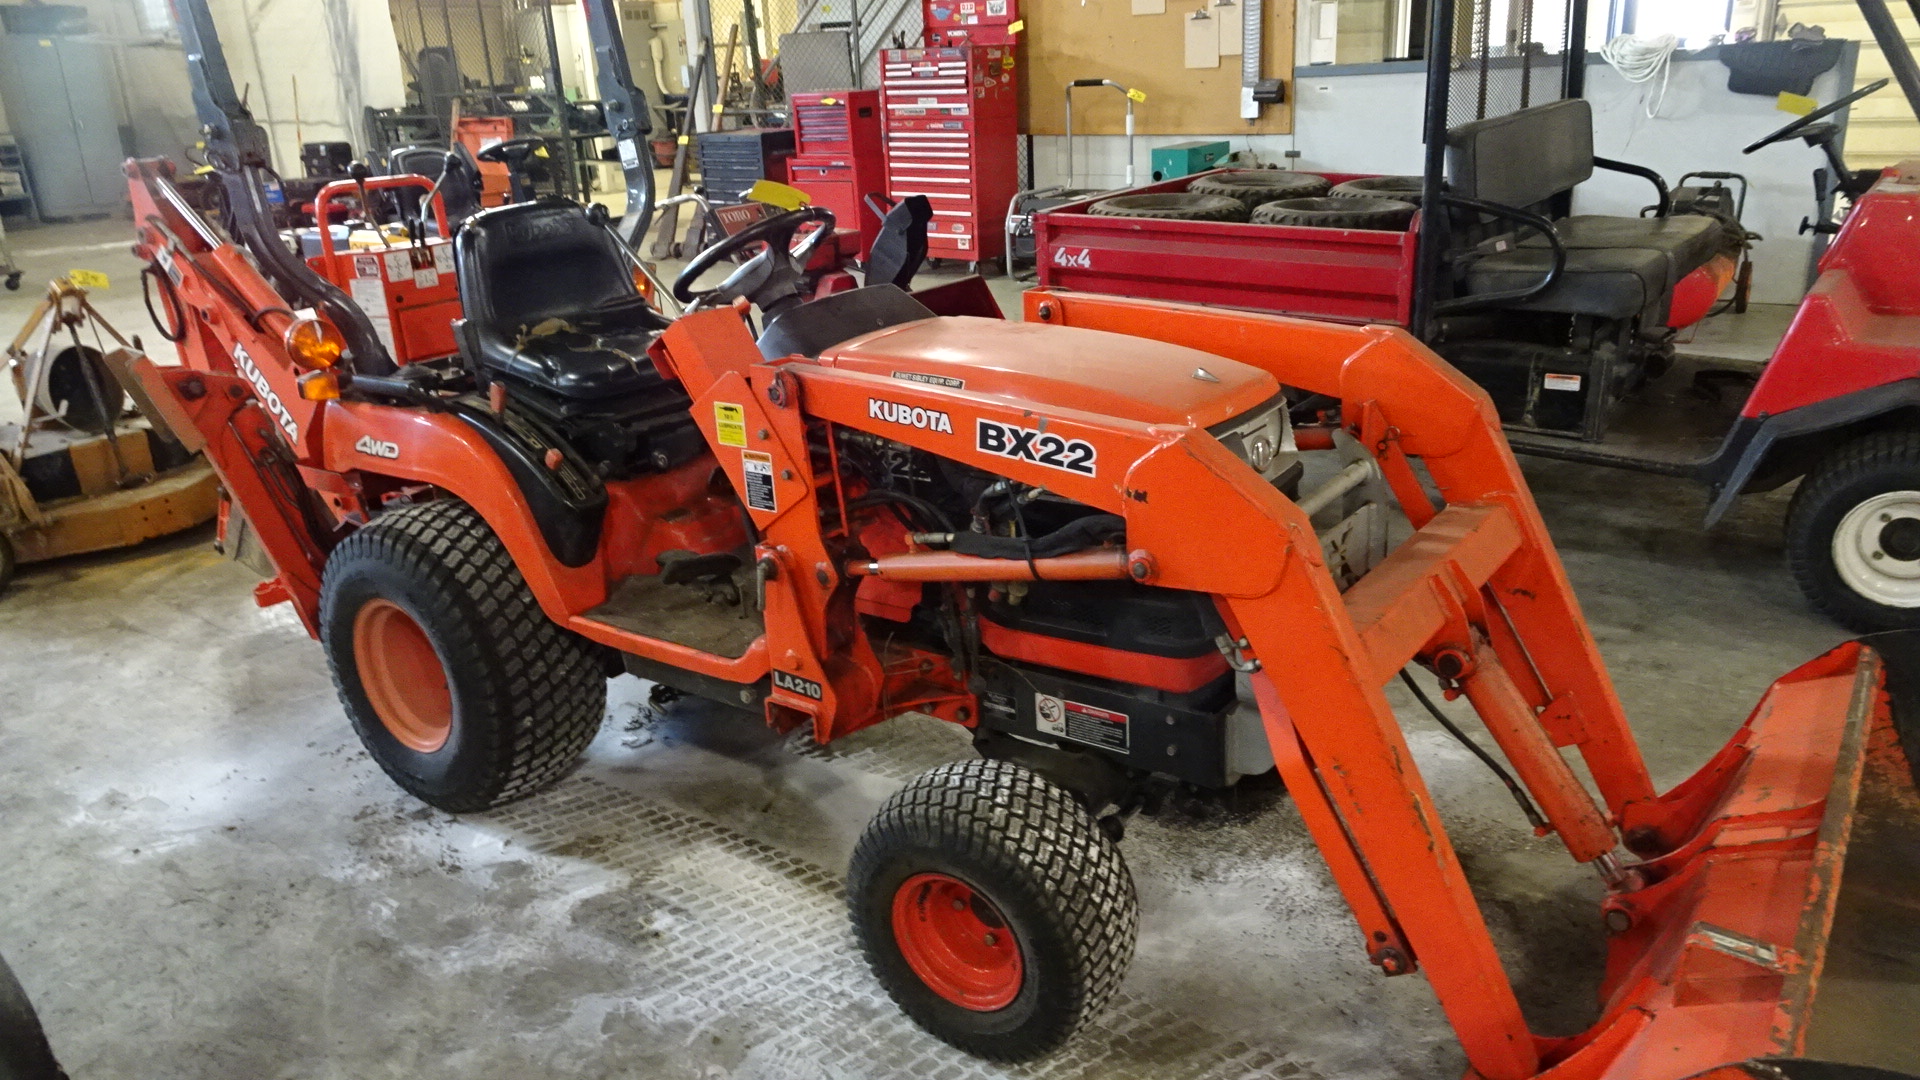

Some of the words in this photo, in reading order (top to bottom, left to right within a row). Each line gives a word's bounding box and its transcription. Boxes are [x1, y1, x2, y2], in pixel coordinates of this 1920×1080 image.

[720, 210, 751, 223] TORO
[1054, 247, 1091, 268] 4x4
[233, 341, 298, 445] KUBOTA
[868, 398, 953, 434] KUBOTA
[976, 418, 1096, 477] BX22
[774, 671, 821, 699] LA210
